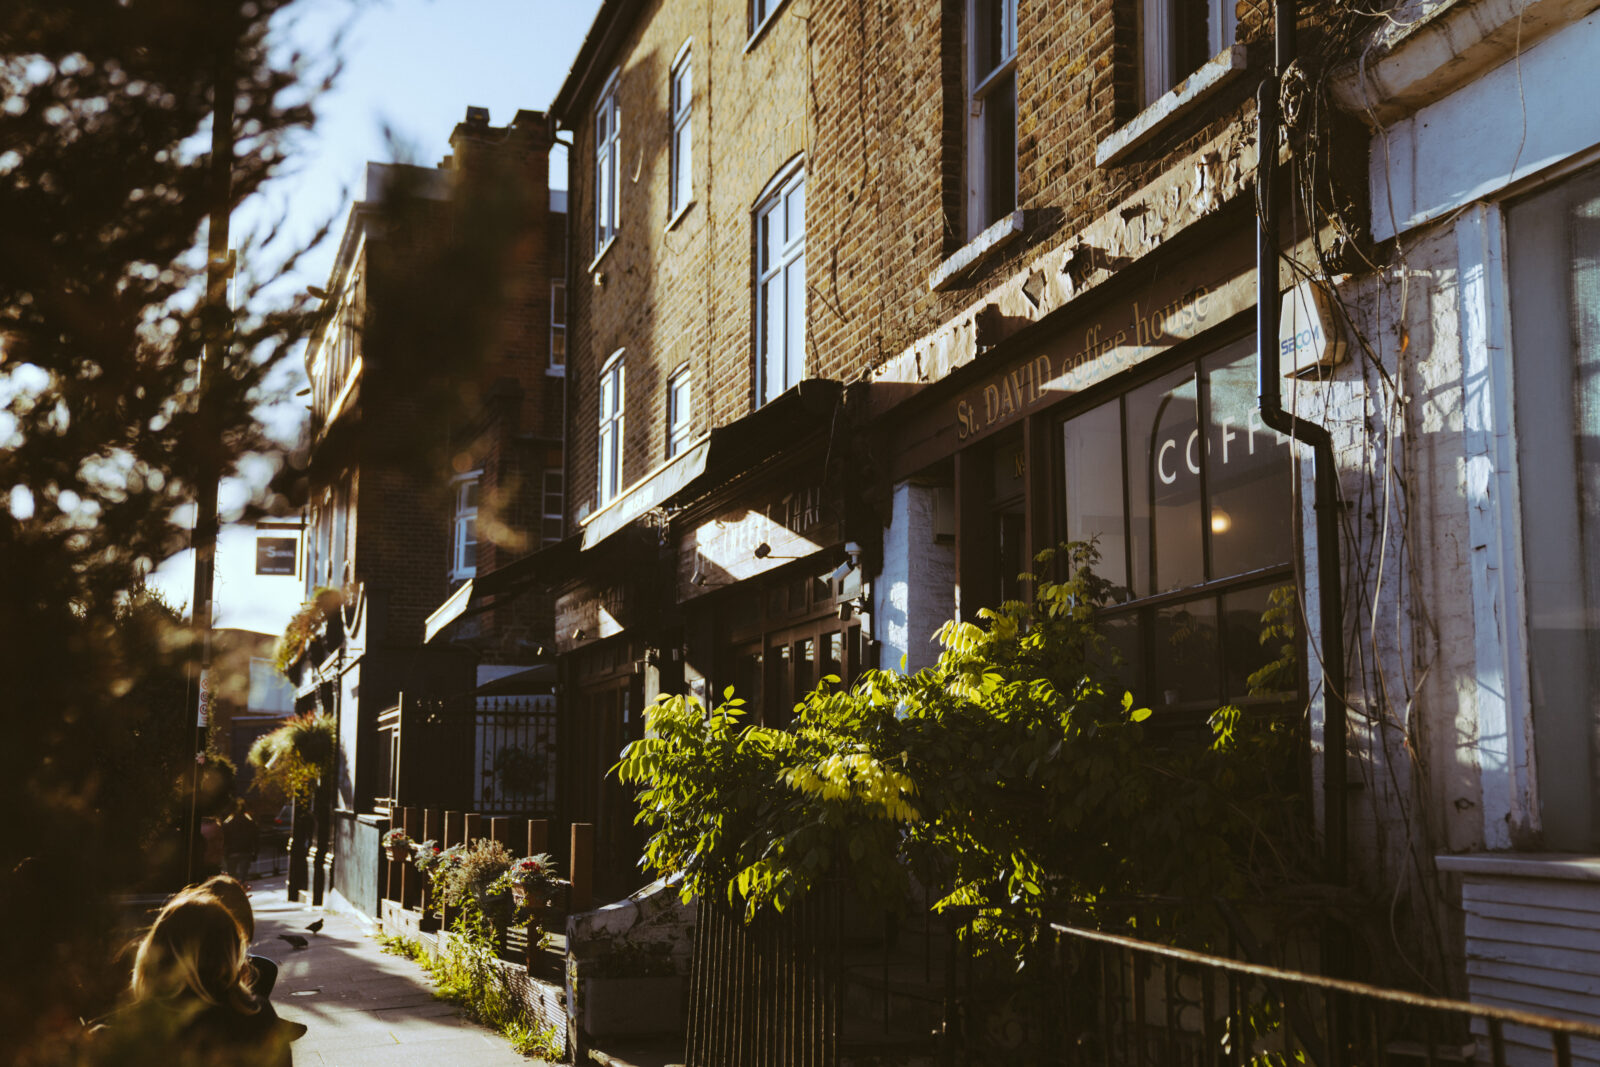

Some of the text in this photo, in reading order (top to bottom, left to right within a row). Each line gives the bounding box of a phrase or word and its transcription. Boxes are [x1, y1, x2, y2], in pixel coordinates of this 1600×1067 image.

[957, 286, 1210, 440] St. DAVID coffee house
[1281, 325, 1320, 355] SECOM
